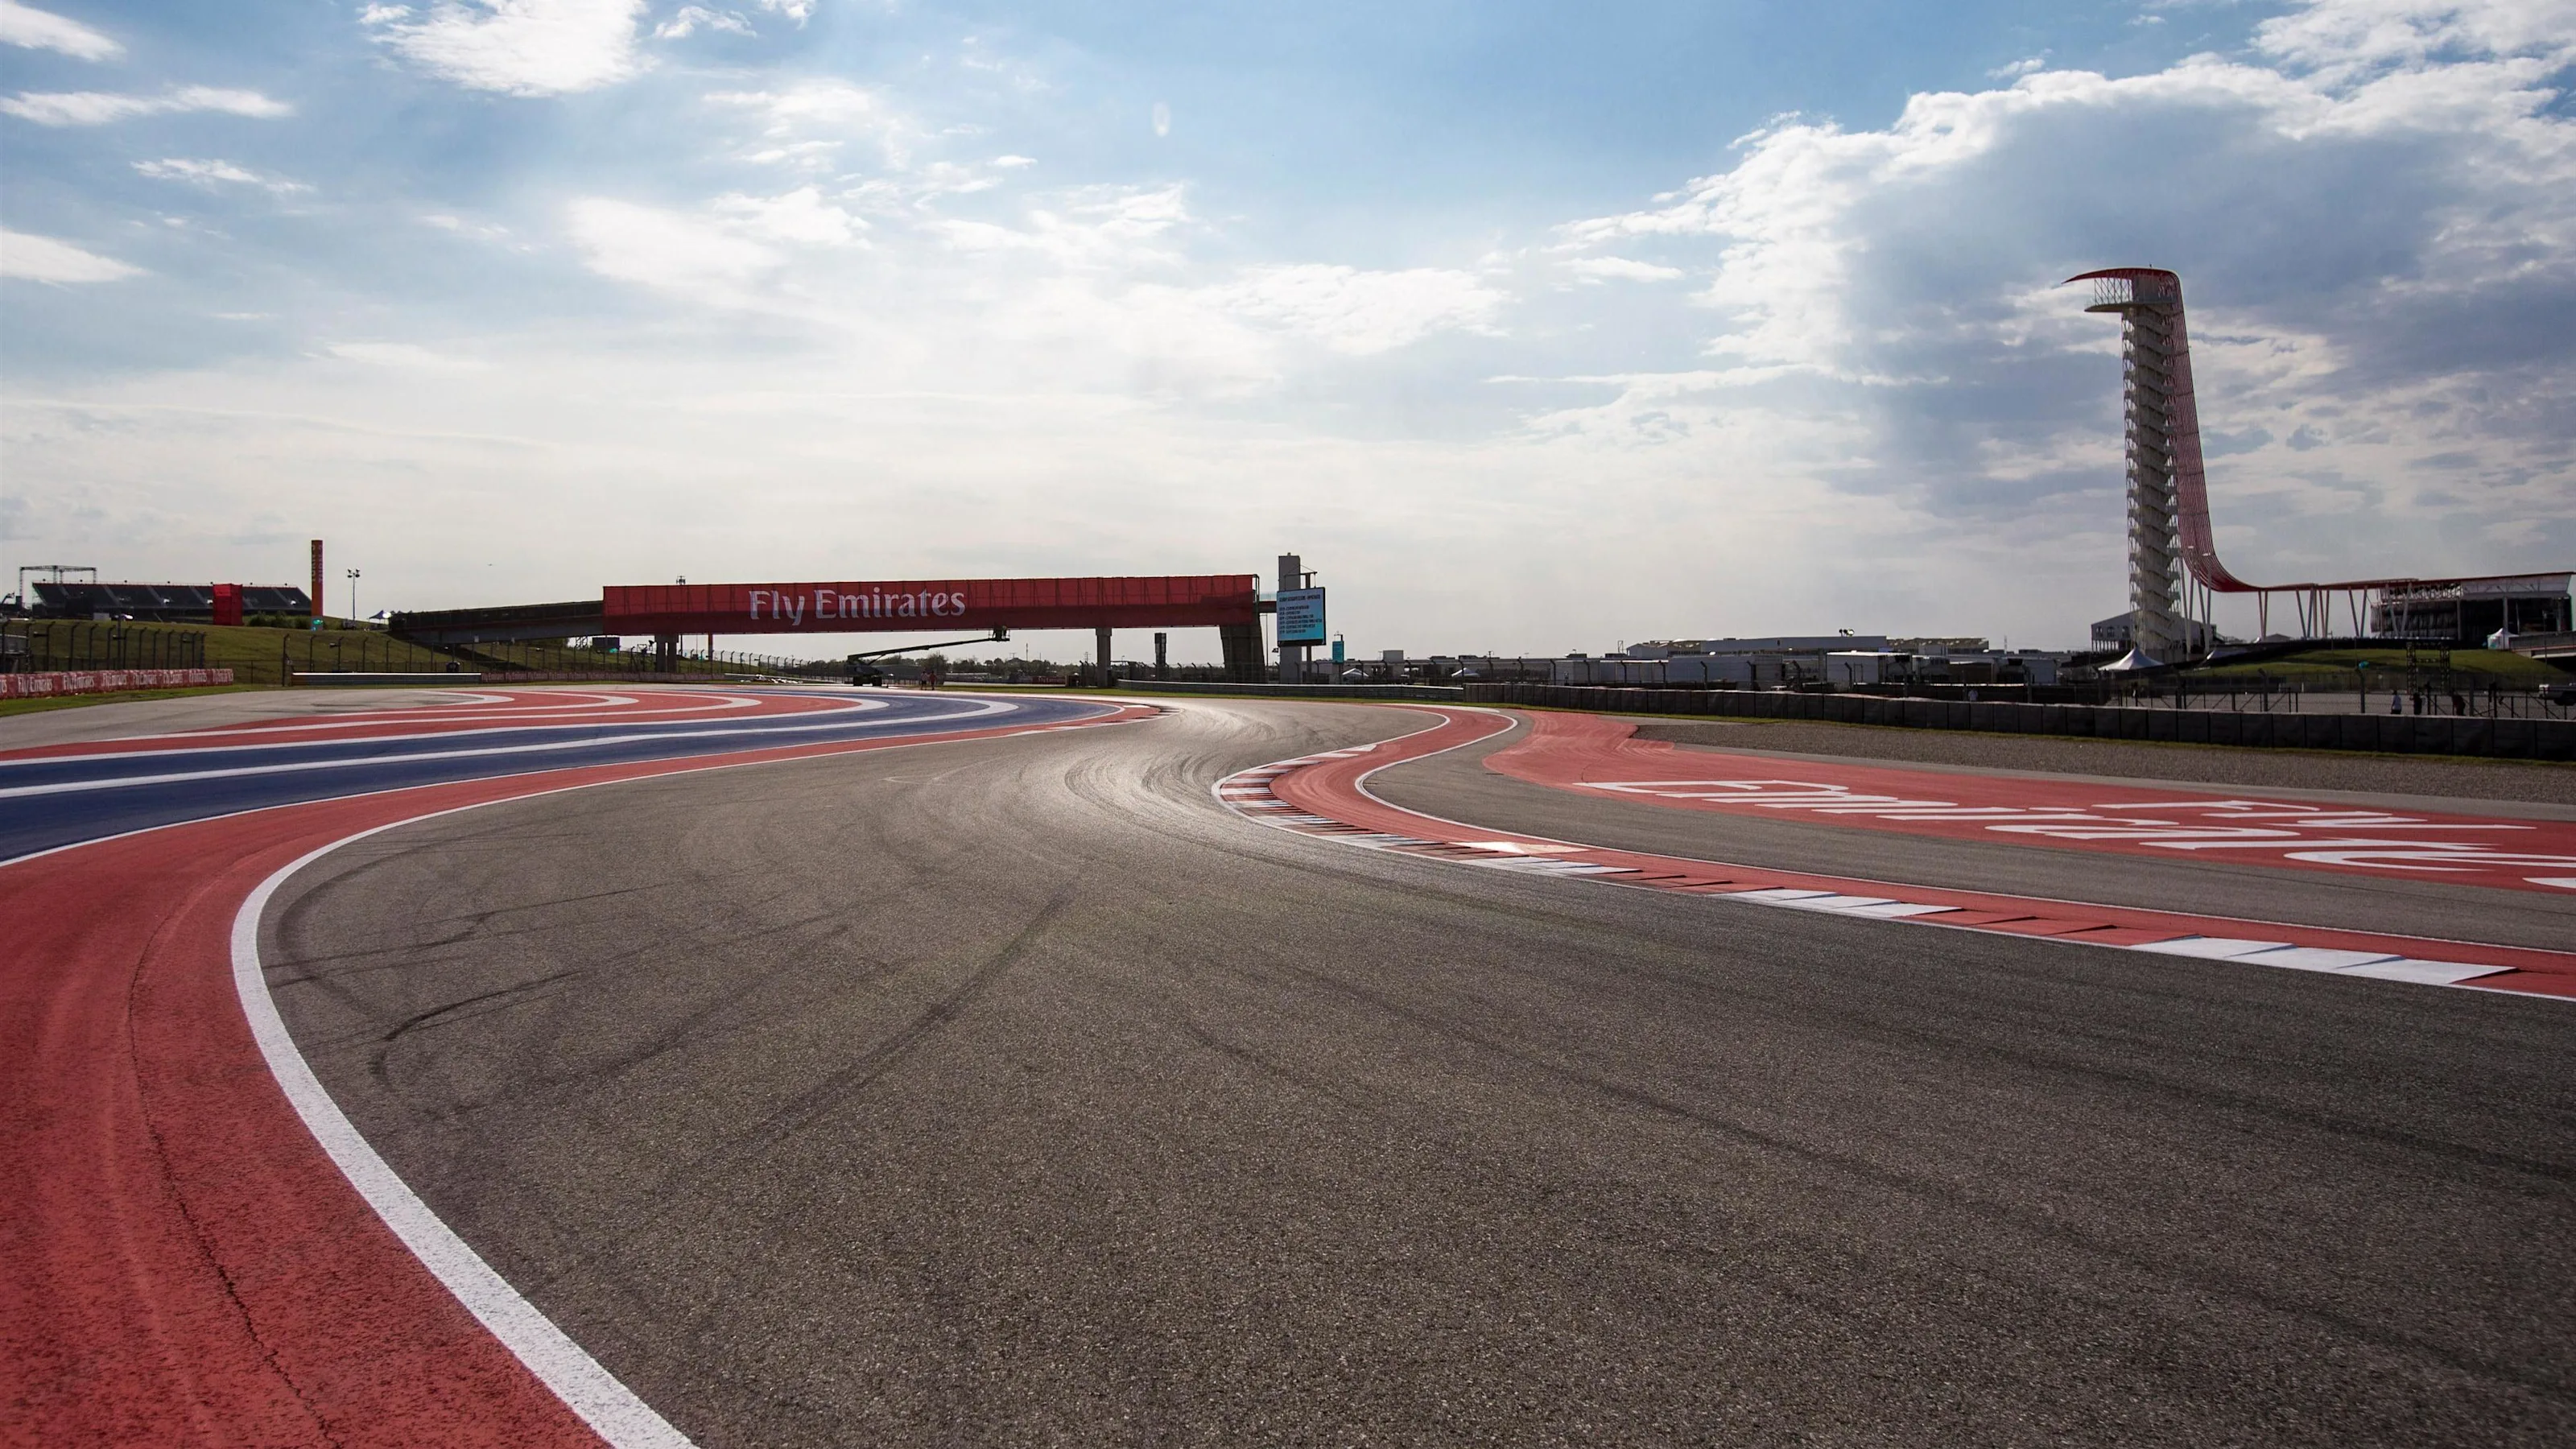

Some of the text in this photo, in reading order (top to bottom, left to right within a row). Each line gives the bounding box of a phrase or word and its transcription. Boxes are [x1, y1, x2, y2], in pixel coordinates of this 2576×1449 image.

[749, 587, 965, 625] Fly Emirates
[1572, 779, 2576, 889] Emirate
[2091, 800, 2537, 830] Fly
